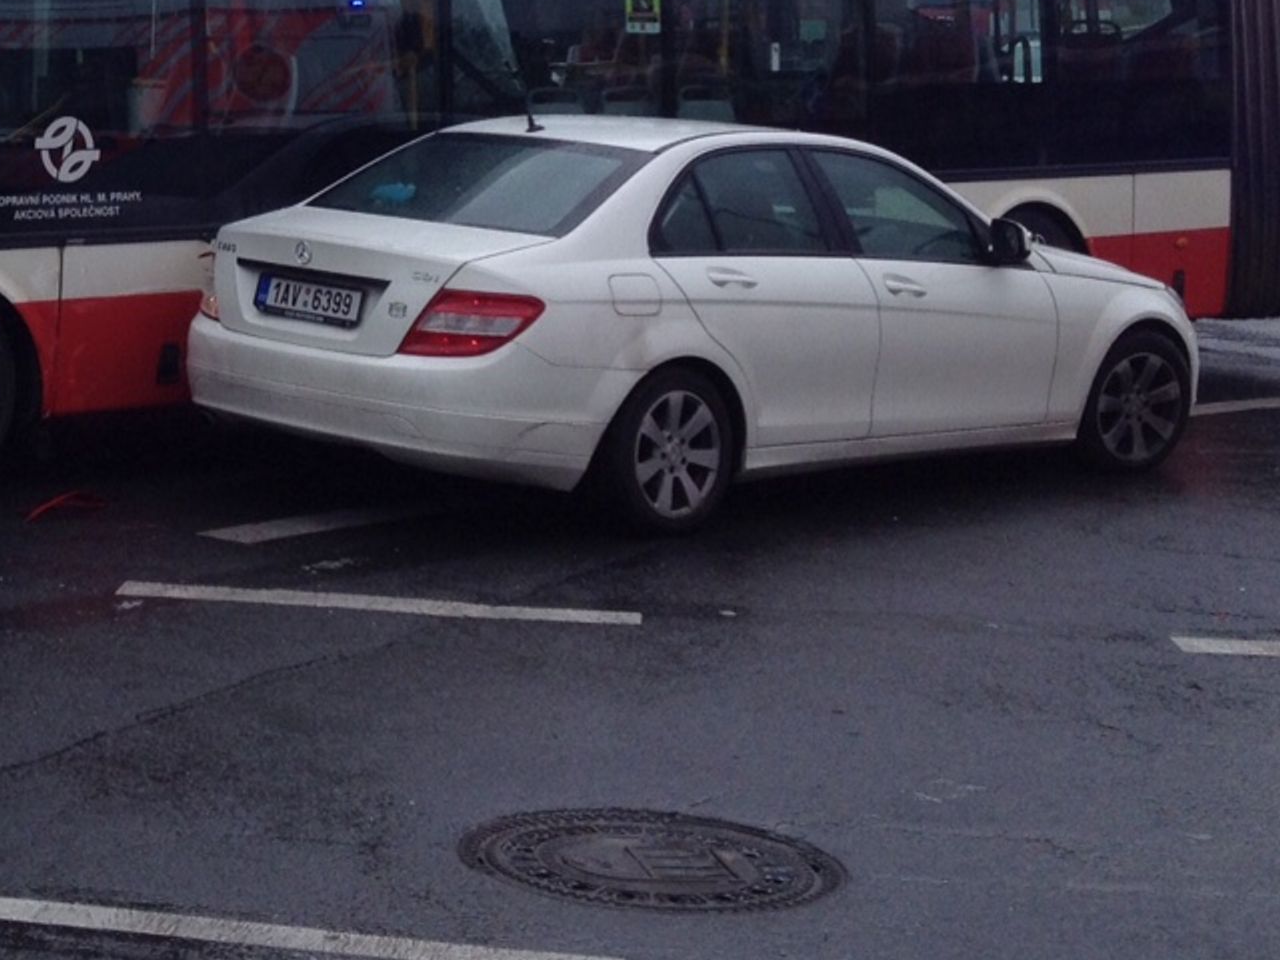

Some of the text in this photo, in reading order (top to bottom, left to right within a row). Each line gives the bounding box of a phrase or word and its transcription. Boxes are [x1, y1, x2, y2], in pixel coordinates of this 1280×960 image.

[42, 193, 78, 205] PODNIK
[13, 204, 120, 220] AKCIOVÁ SPOLEČNOST
[272, 282, 302, 308] 1AV
[311, 286, 354, 316] 6399
